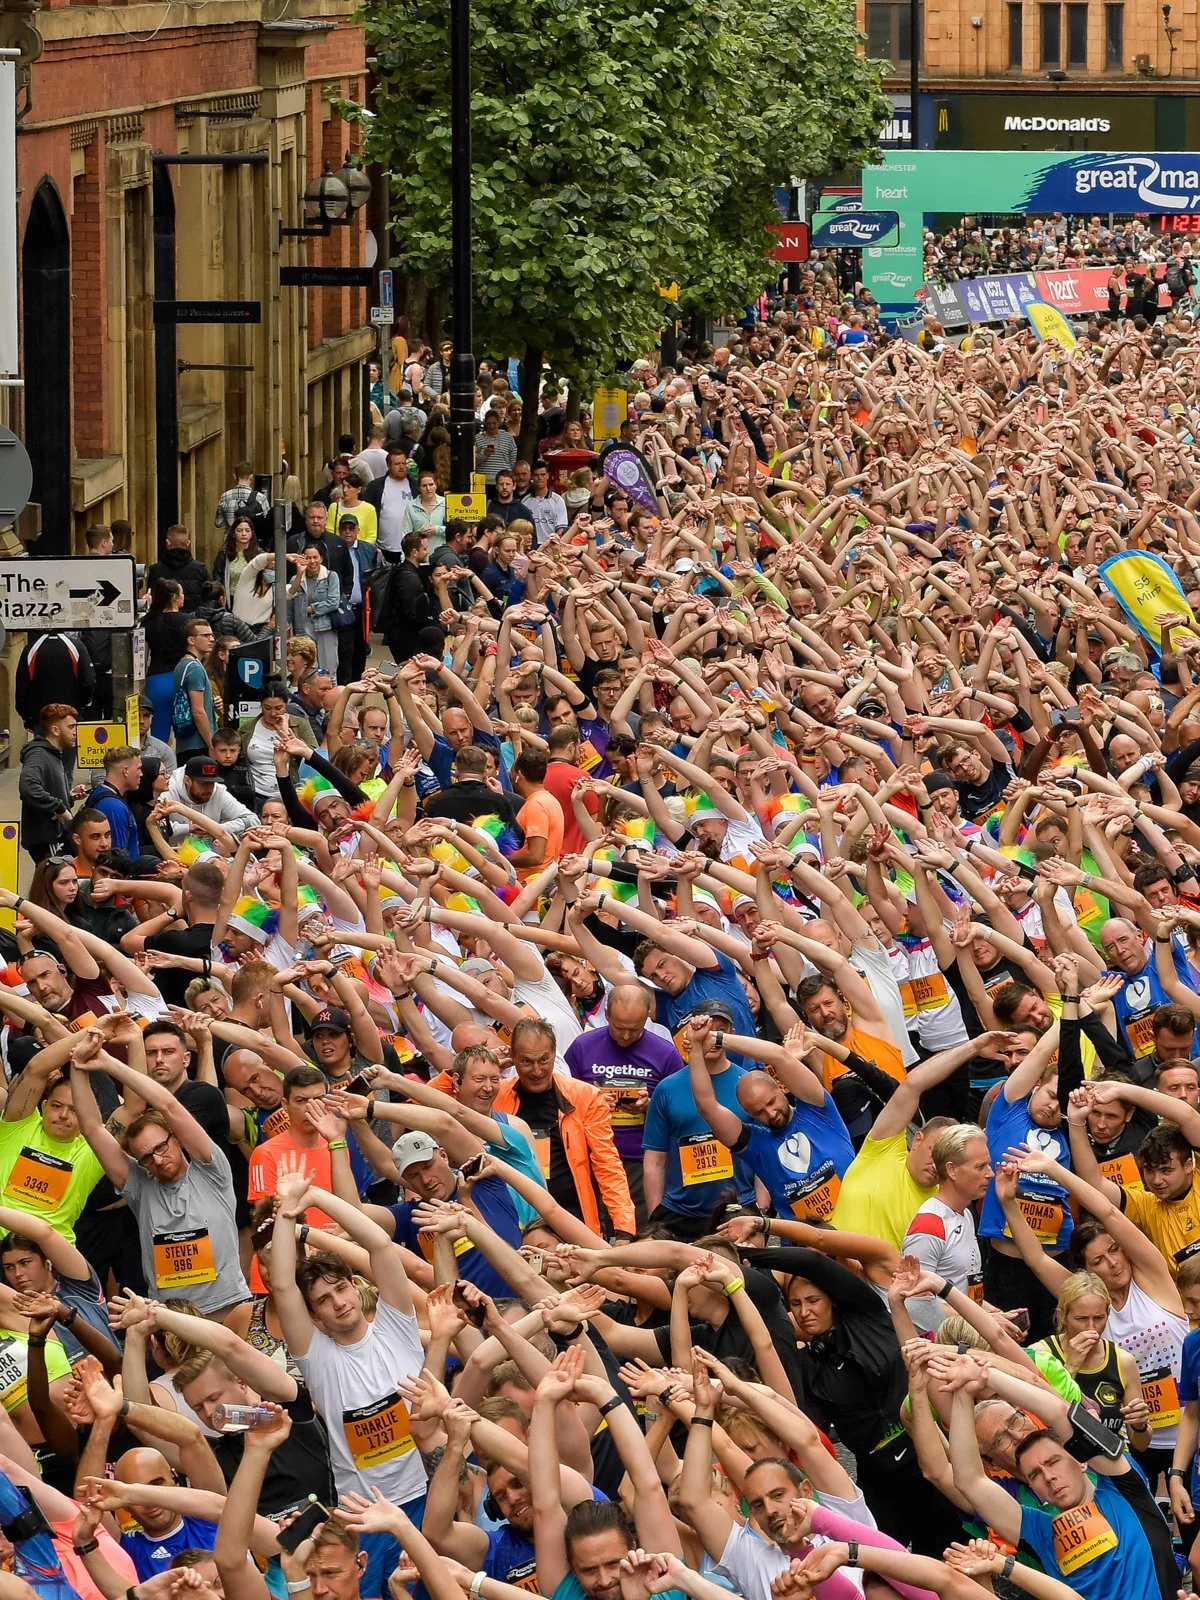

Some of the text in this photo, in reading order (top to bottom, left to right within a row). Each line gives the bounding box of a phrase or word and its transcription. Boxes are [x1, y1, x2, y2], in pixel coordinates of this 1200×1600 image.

[1004, 116, 1111, 132] McDonald's
[1076, 165, 1137, 194] great
[876, 187, 908, 198] heart
[829, 221, 880, 233] great run
[1046, 273, 1079, 300] heart
[454, 508, 479, 516] Parking
[1, 574, 45, 593] The
[1133, 574, 1151, 590] 55
[1136, 583, 1162, 606] Mins
[244, 660, 260, 683] P
[87, 746, 111, 755] Parki
[80, 757, 104, 766] Suspe
[916, 978, 930, 989] PHIL
[591, 1063, 653, 1079] together.
[692, 1144, 718, 1158] SIMON
[696, 1155, 718, 1170] 2916
[1101, 1162, 1122, 1174] LAN
[24, 1175, 50, 1193] 3343
[804, 1186, 831, 1210] PHILIP
[816, 1200, 835, 1218] 982
[1019, 1202, 1054, 1219] THOMAS
[165, 1243, 199, 1259] STEVEN
[173, 1257, 193, 1272] 996
[353, 1410, 397, 1437] CHARLIE
[366, 1428, 393, 1449] 1737
[1058, 1526, 1087, 1553] 1187
